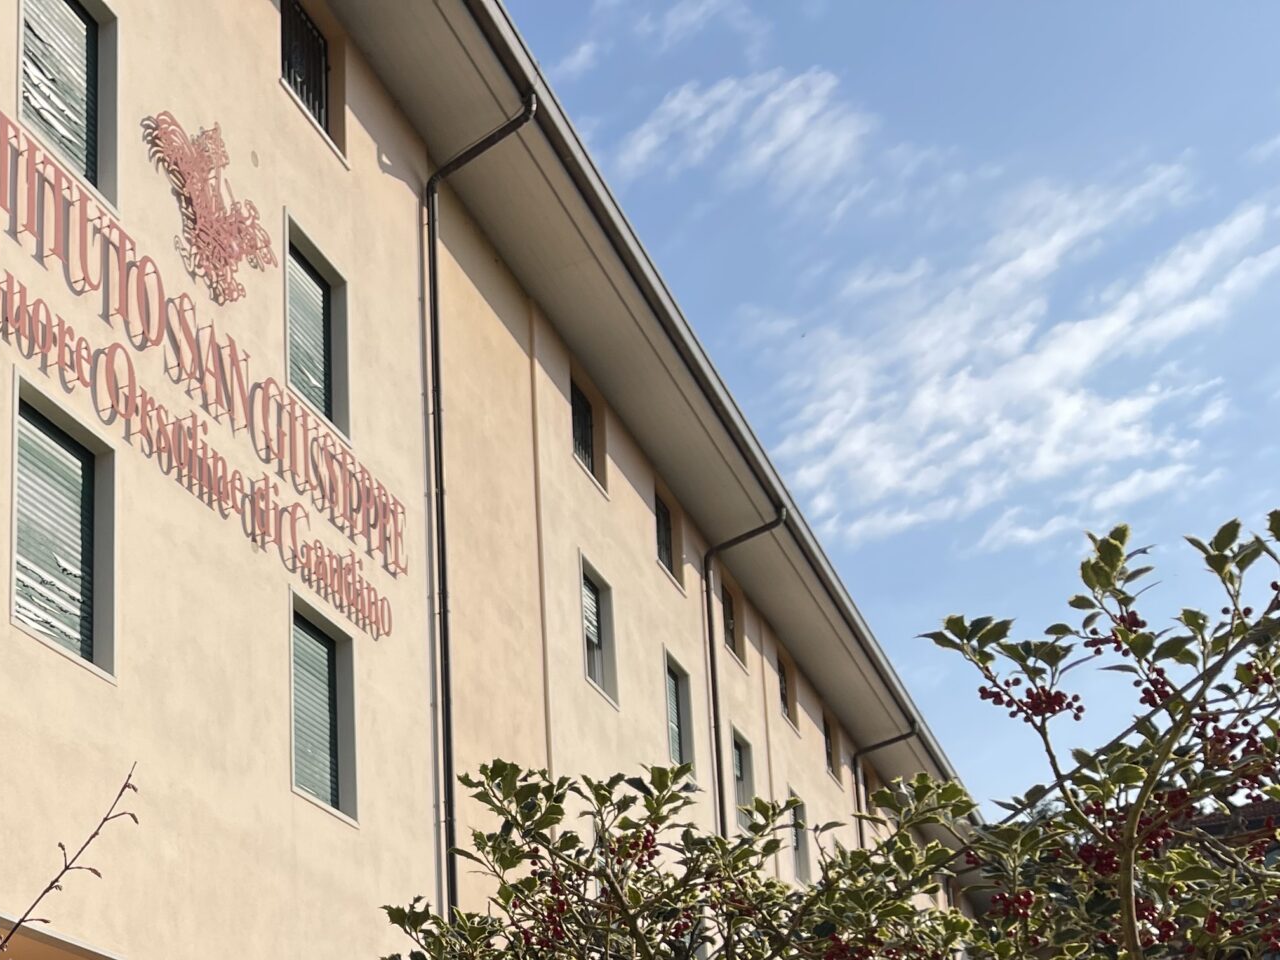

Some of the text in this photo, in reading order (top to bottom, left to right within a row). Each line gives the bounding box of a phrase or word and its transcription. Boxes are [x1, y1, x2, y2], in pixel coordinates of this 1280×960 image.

[105, 342, 244, 516] Orsoline
[254, 471, 281, 547] di
[290, 502, 393, 638] Gandino
[177, 292, 250, 435] SAN
[261, 376, 409, 577] GIUSEPPE
